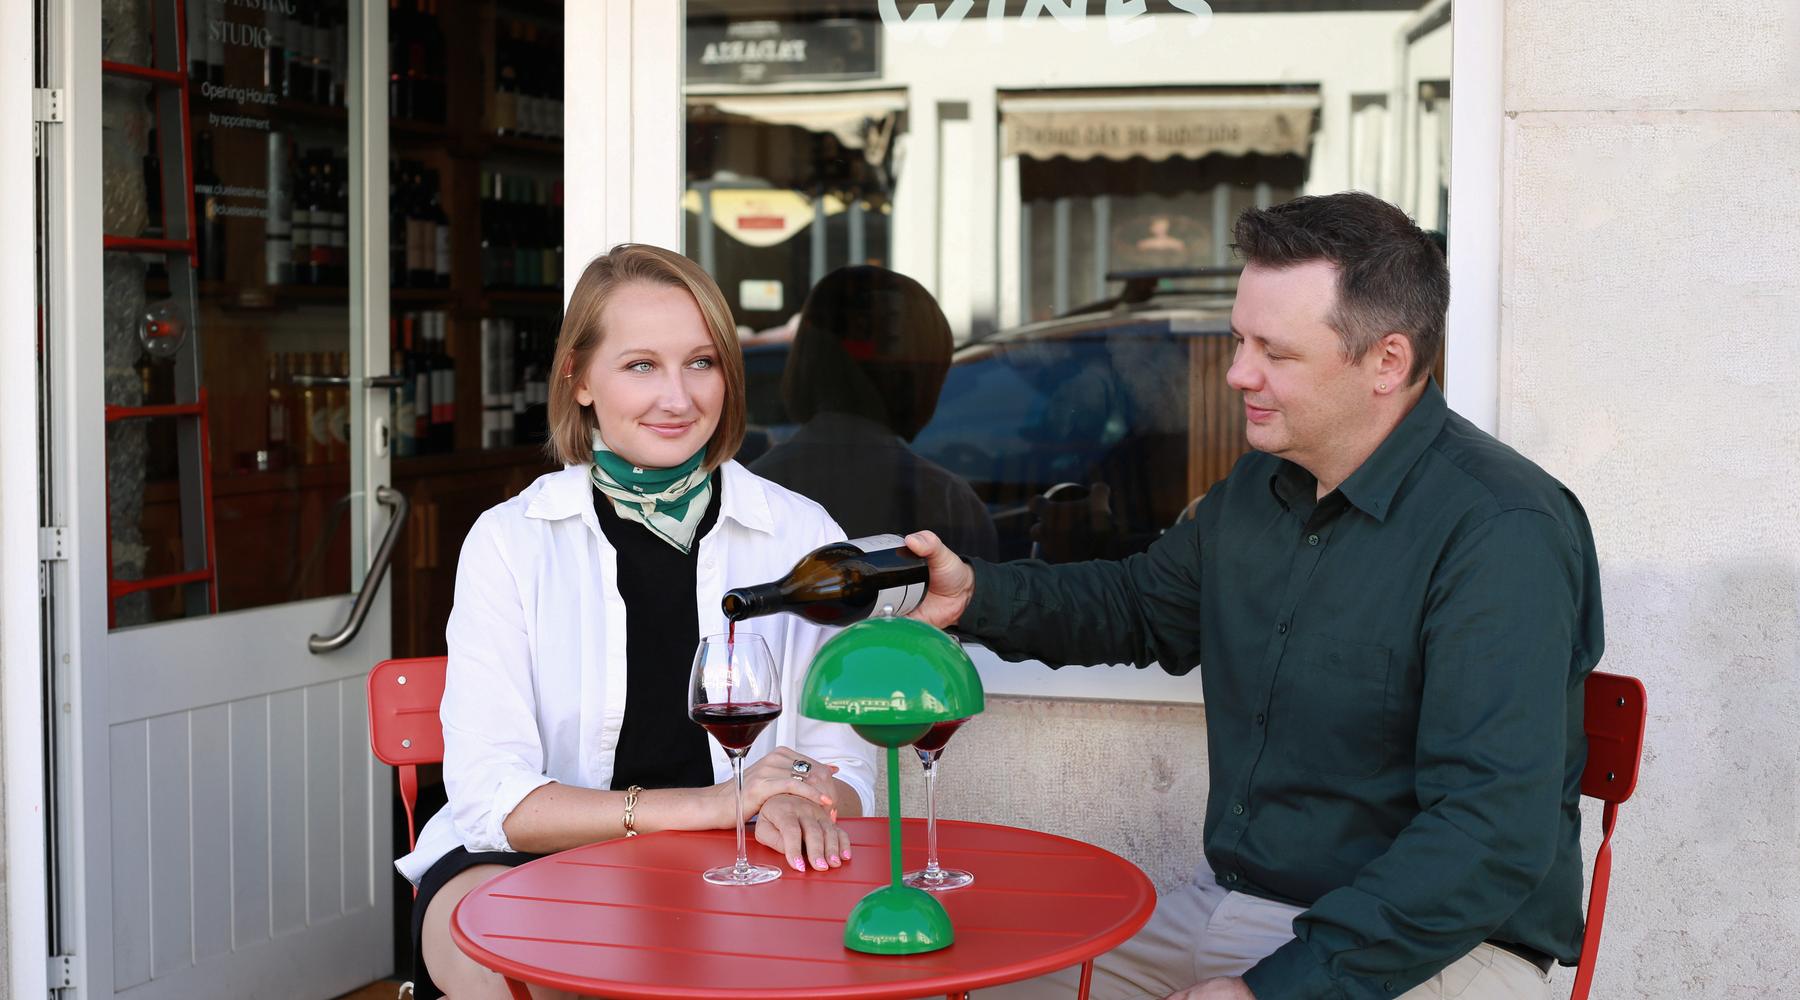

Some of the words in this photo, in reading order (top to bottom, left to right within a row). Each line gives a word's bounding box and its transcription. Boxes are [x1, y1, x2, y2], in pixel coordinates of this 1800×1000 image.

[208, 19, 270, 48] STUDIO
[878, 0, 1214, 47] WINES
[201, 81, 245, 105] Opening
[246, 87, 278, 105] Hours:
[209, 113, 219, 127] by
[220, 115, 271, 130] appointment
